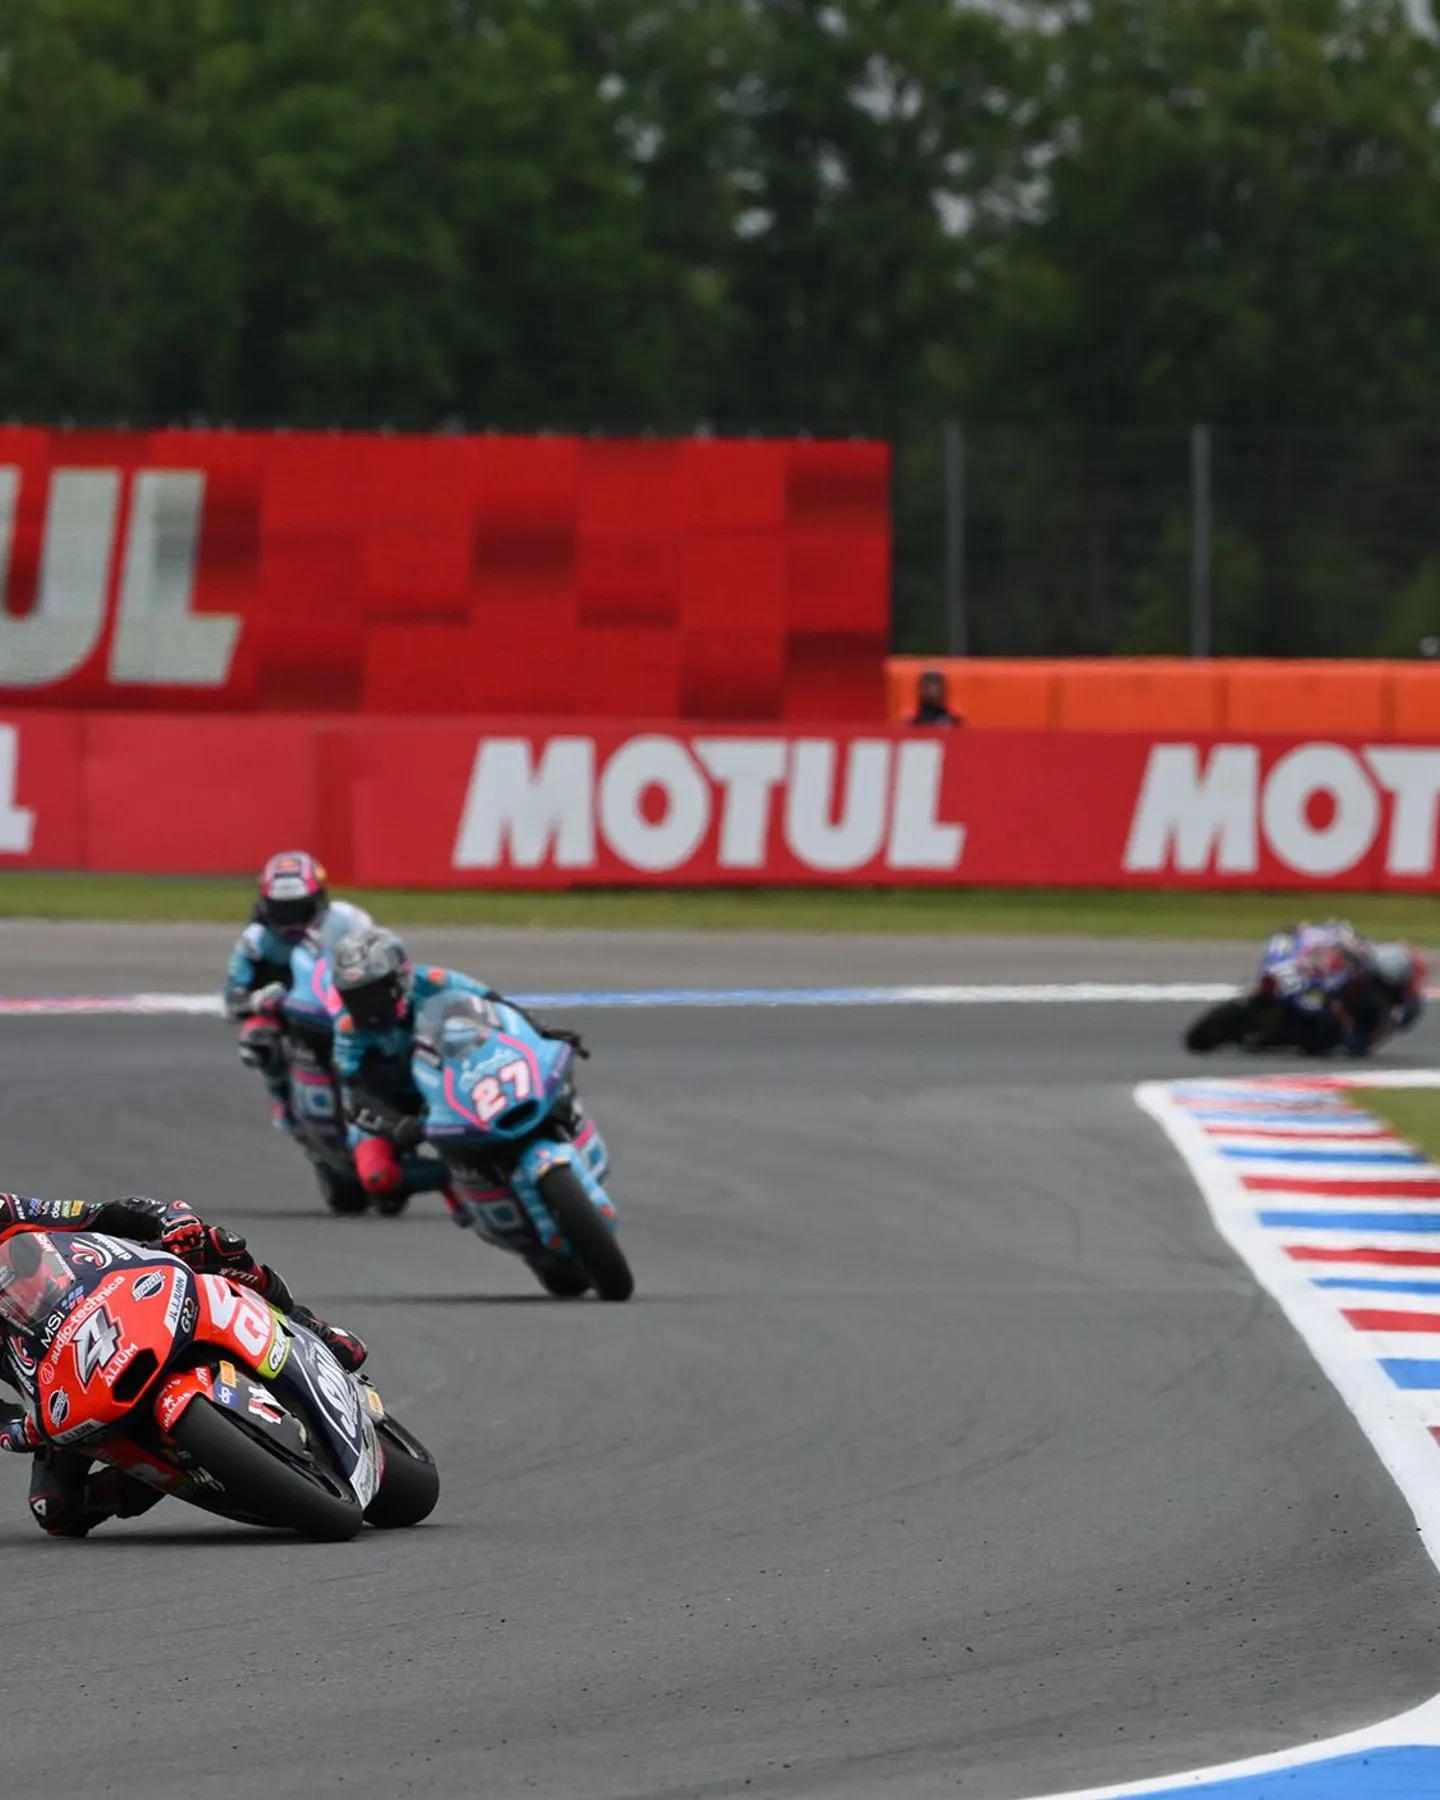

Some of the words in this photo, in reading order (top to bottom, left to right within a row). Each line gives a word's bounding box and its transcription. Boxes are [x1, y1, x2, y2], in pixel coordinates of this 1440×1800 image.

[452, 735, 966, 872] MOTUL
[1122, 741, 1440, 876] MOT
[472, 1059, 530, 1123] 27
[40, 1311, 66, 1350] MSI
[50, 1275, 127, 1365] audio-technica
[72, 1305, 119, 1384] 4
[104, 1342, 139, 1388] ALIUM
